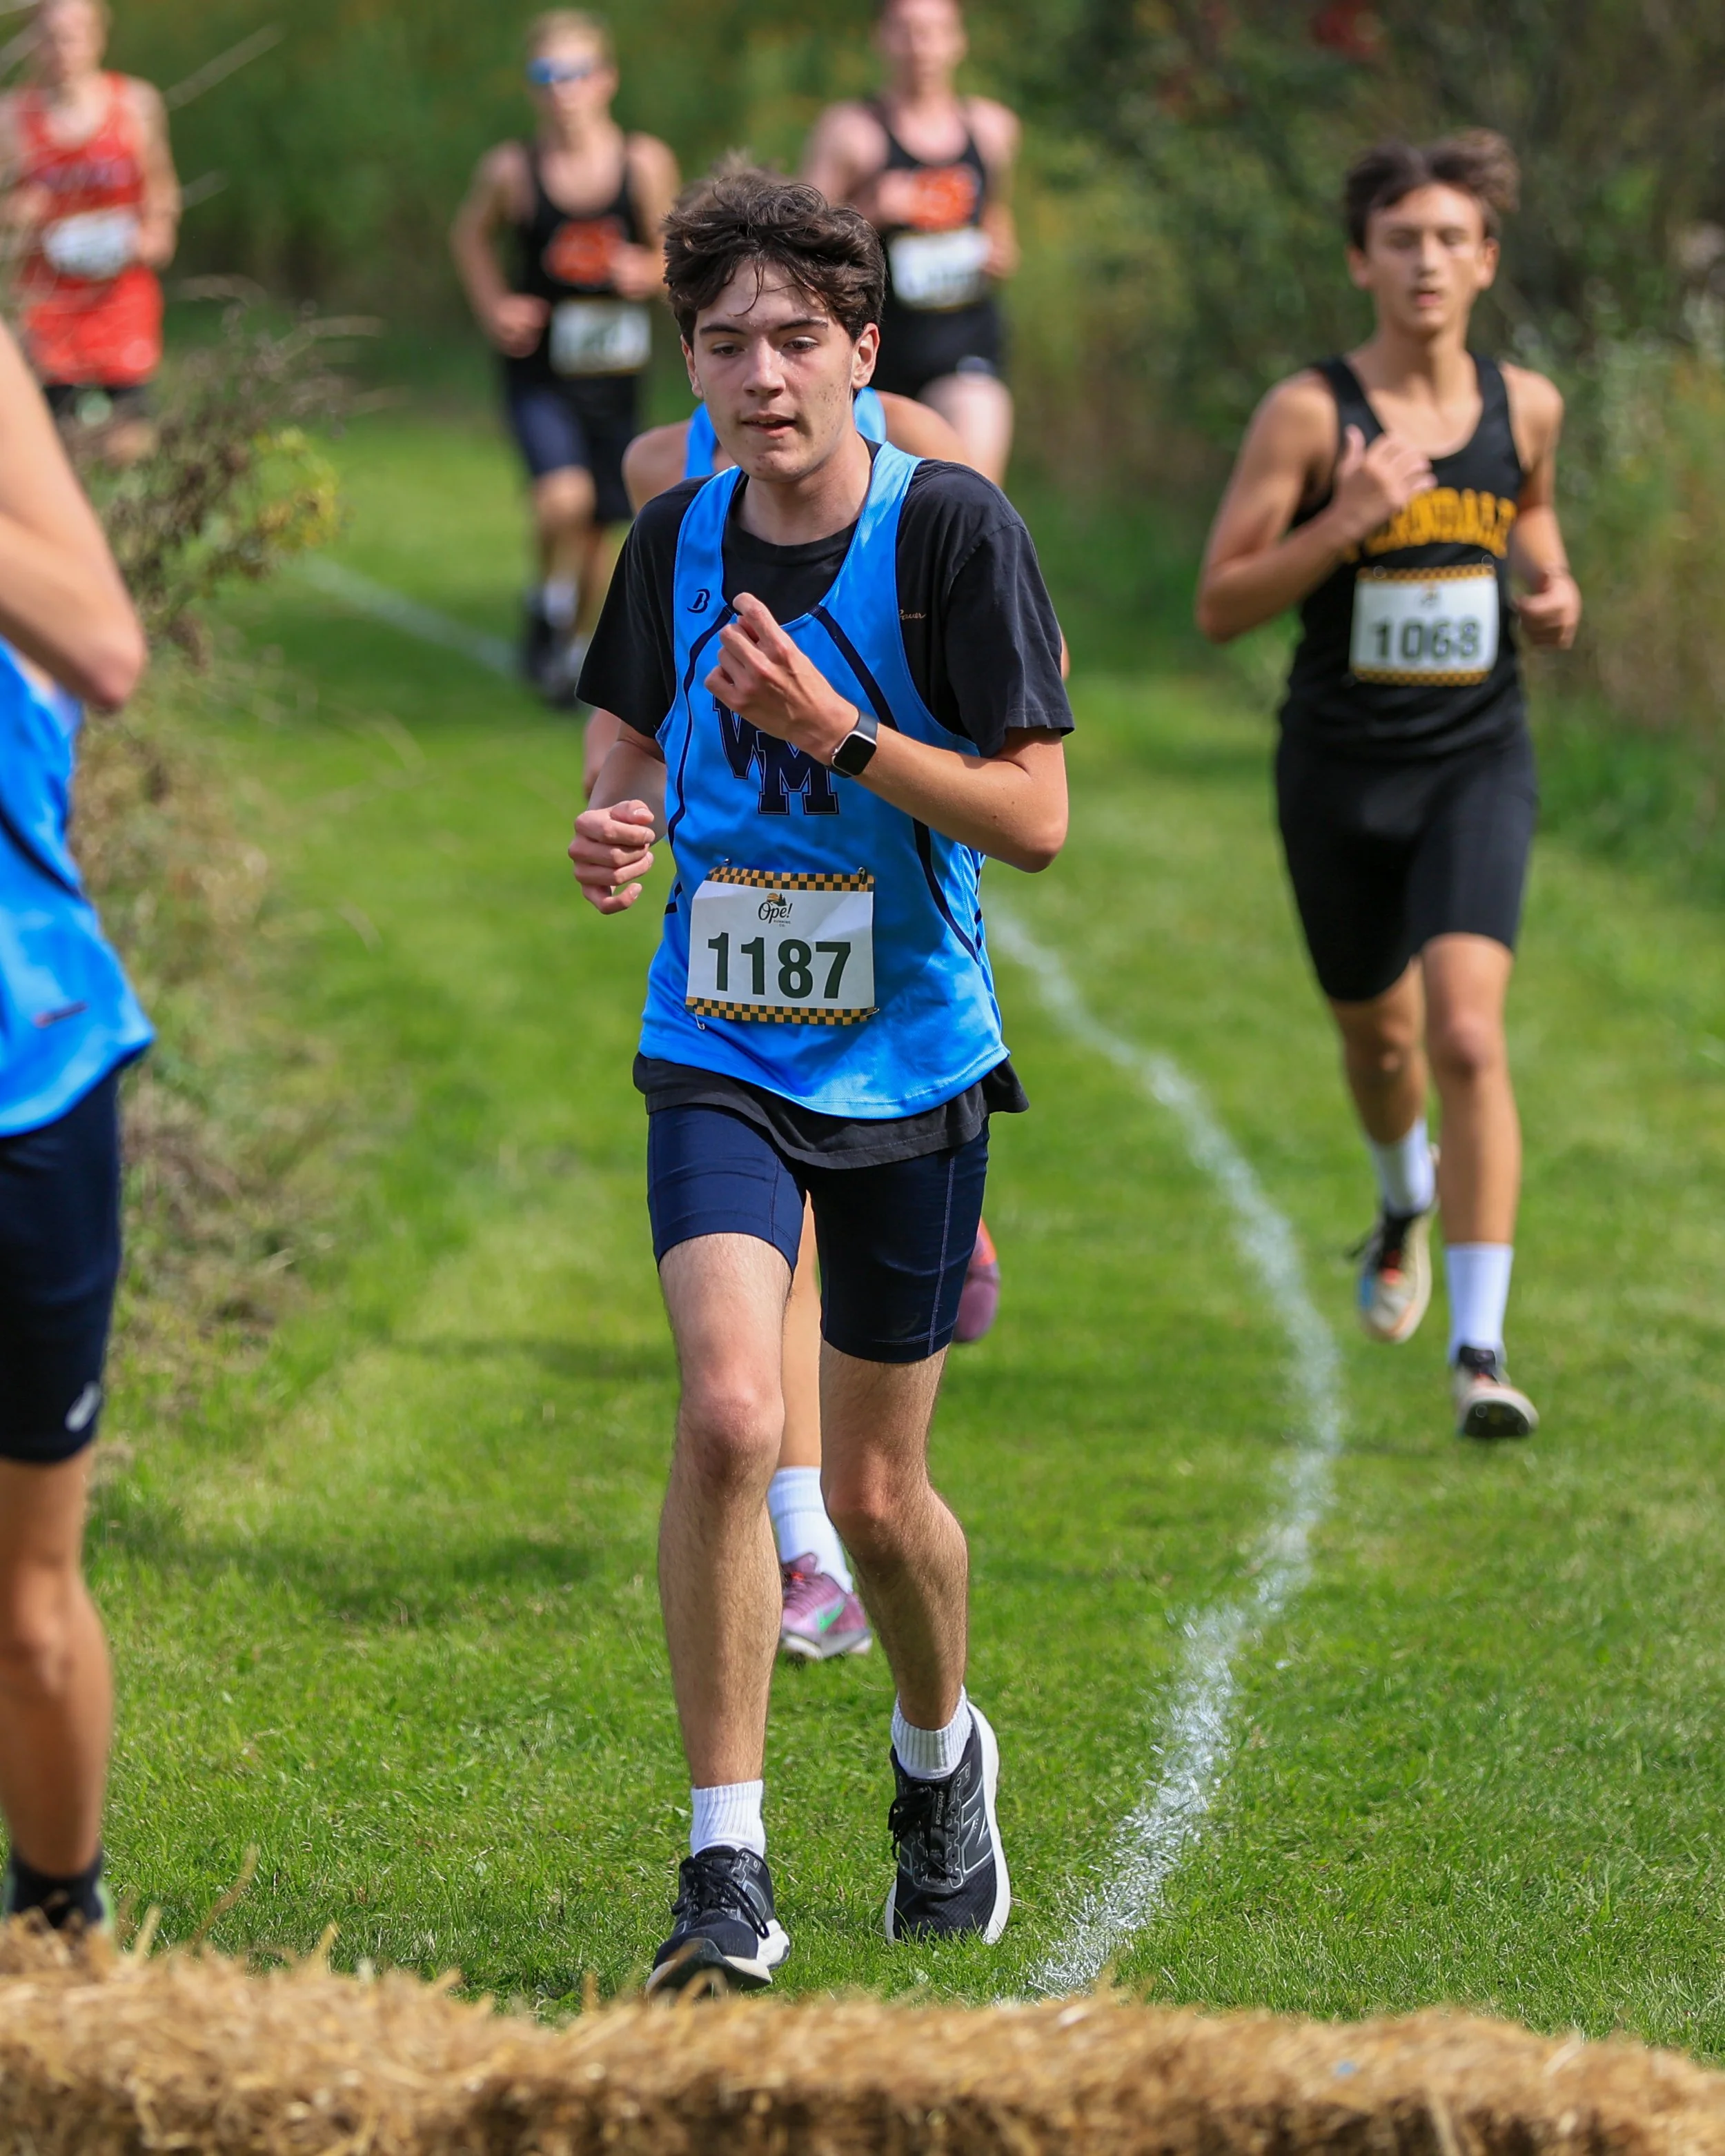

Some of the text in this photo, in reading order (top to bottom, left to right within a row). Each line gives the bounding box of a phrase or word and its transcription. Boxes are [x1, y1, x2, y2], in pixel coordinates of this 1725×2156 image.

[1372, 619, 1479, 660] 1068
[758, 902, 793, 924] Ope!
[707, 931, 851, 1000] 1187
